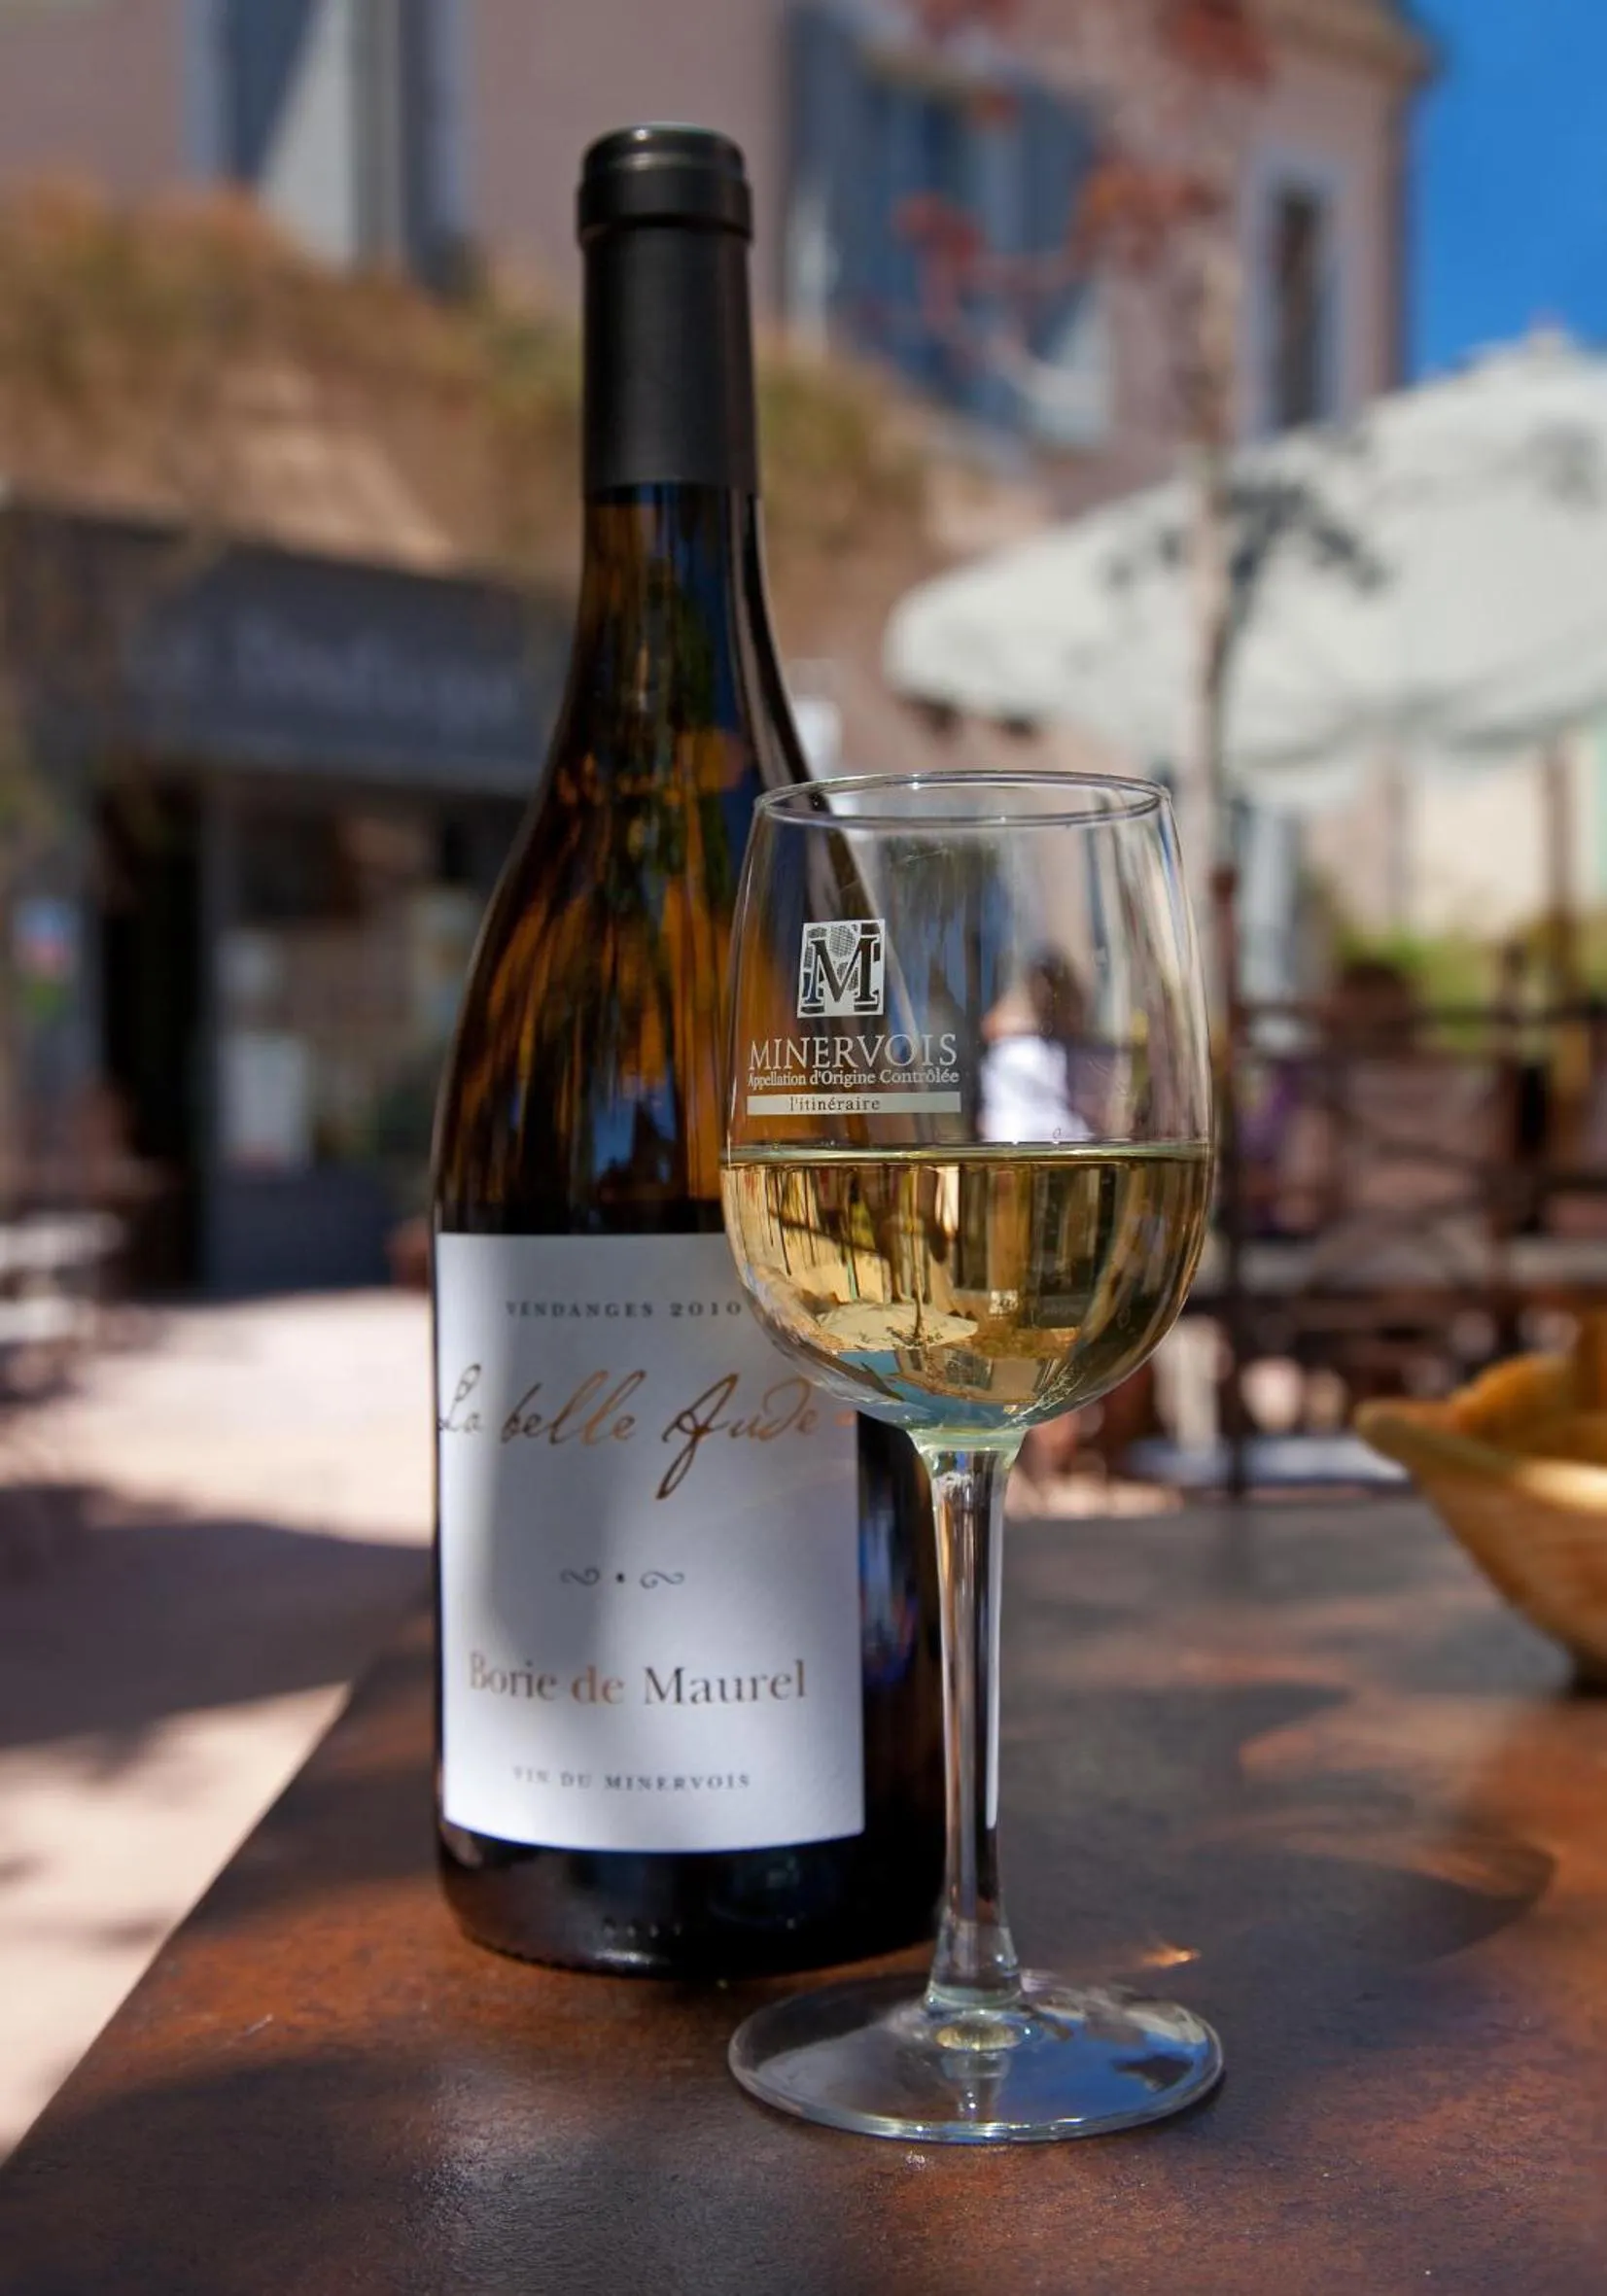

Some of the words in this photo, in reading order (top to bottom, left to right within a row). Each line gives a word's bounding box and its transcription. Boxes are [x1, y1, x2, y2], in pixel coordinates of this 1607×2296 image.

[750, 1033, 958, 1070] MINERVOIS
[748, 1073, 807, 1089] Appellation
[809, 1069, 876, 1088] d'Origine
[879, 1068, 961, 1085] Contrôlée
[788, 1095, 882, 1112] l'itinéraire
[505, 1301, 655, 1319] VENDANGES
[669, 1301, 744, 1318] 2010
[438, 1363, 484, 1436] La
[500, 1369, 647, 1446] belle
[655, 1373, 821, 1501] Aude
[468, 1652, 560, 1703] Borie
[570, 1664, 627, 1705] de
[643, 1658, 809, 1706] Maurel
[511, 1766, 549, 1785] VIN
[559, 1771, 594, 1789] DU
[603, 1773, 752, 1792] MINERVOIS
